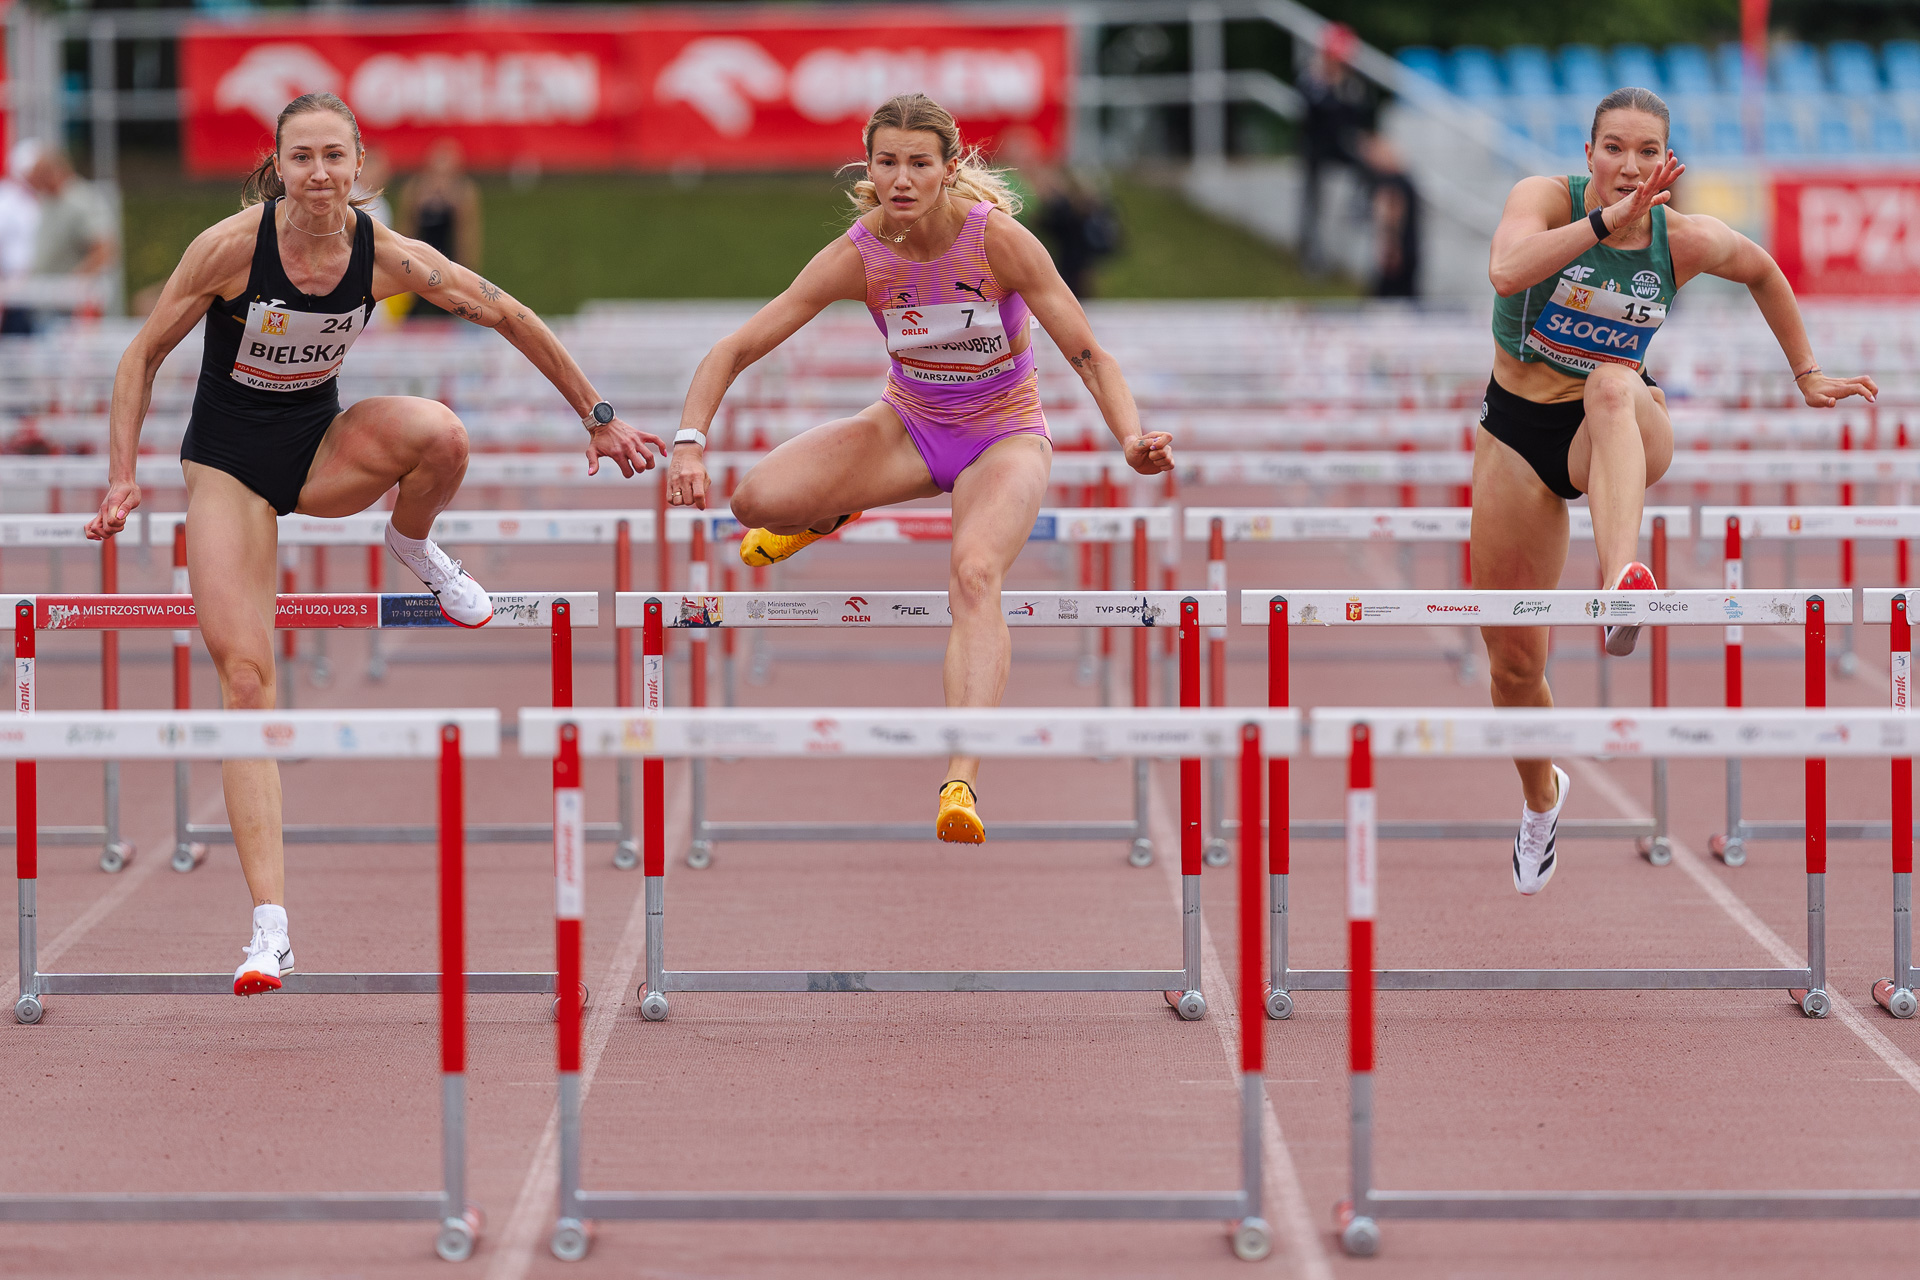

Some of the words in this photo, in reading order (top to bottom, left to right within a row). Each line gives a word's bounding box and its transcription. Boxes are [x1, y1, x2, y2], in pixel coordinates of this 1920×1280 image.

[1801, 187, 1920, 272] PZ
[1563, 264, 1595, 282] 4F
[1638, 274, 1656, 284] AZS
[1606, 278, 1616, 292] AW
[1636, 285, 1657, 297] AWF
[960, 308, 975, 329] 7
[1621, 302, 1652, 324] 15
[320, 315, 353, 334] 24
[901, 327, 929, 336] ORLEN
[1546, 313, 1639, 351] SŁOCKA
[249, 341, 346, 364] BIELSKA
[1540, 344, 1596, 371] WARSZAWA
[914, 370, 974, 383] WARSZAWA
[976, 366, 1001, 381] 2025
[247, 376, 309, 390] WARSZAWA
[405, 599, 440, 607] WARSZA
[767, 600, 807, 608] Ministerstwo
[1095, 605, 1114, 614] TVP
[1648, 601, 1689, 614] Okęcie
[83, 605, 165, 615] MISTRZOSTWA
[166, 605, 196, 615] POLS
[305, 604, 332, 617] U20,
[333, 604, 360, 617] U23,
[360, 604, 368, 615] S
[391, 609, 411, 618] 17-19
[413, 609, 442, 618] CZERW
[767, 607, 787, 616] Sportu
[792, 607, 819, 616] Turystyki
[901, 606, 930, 615] FUEL
[841, 615, 871, 623] ORLEN
[18, 680, 30, 713] lanik
[646, 678, 658, 711] lanik
